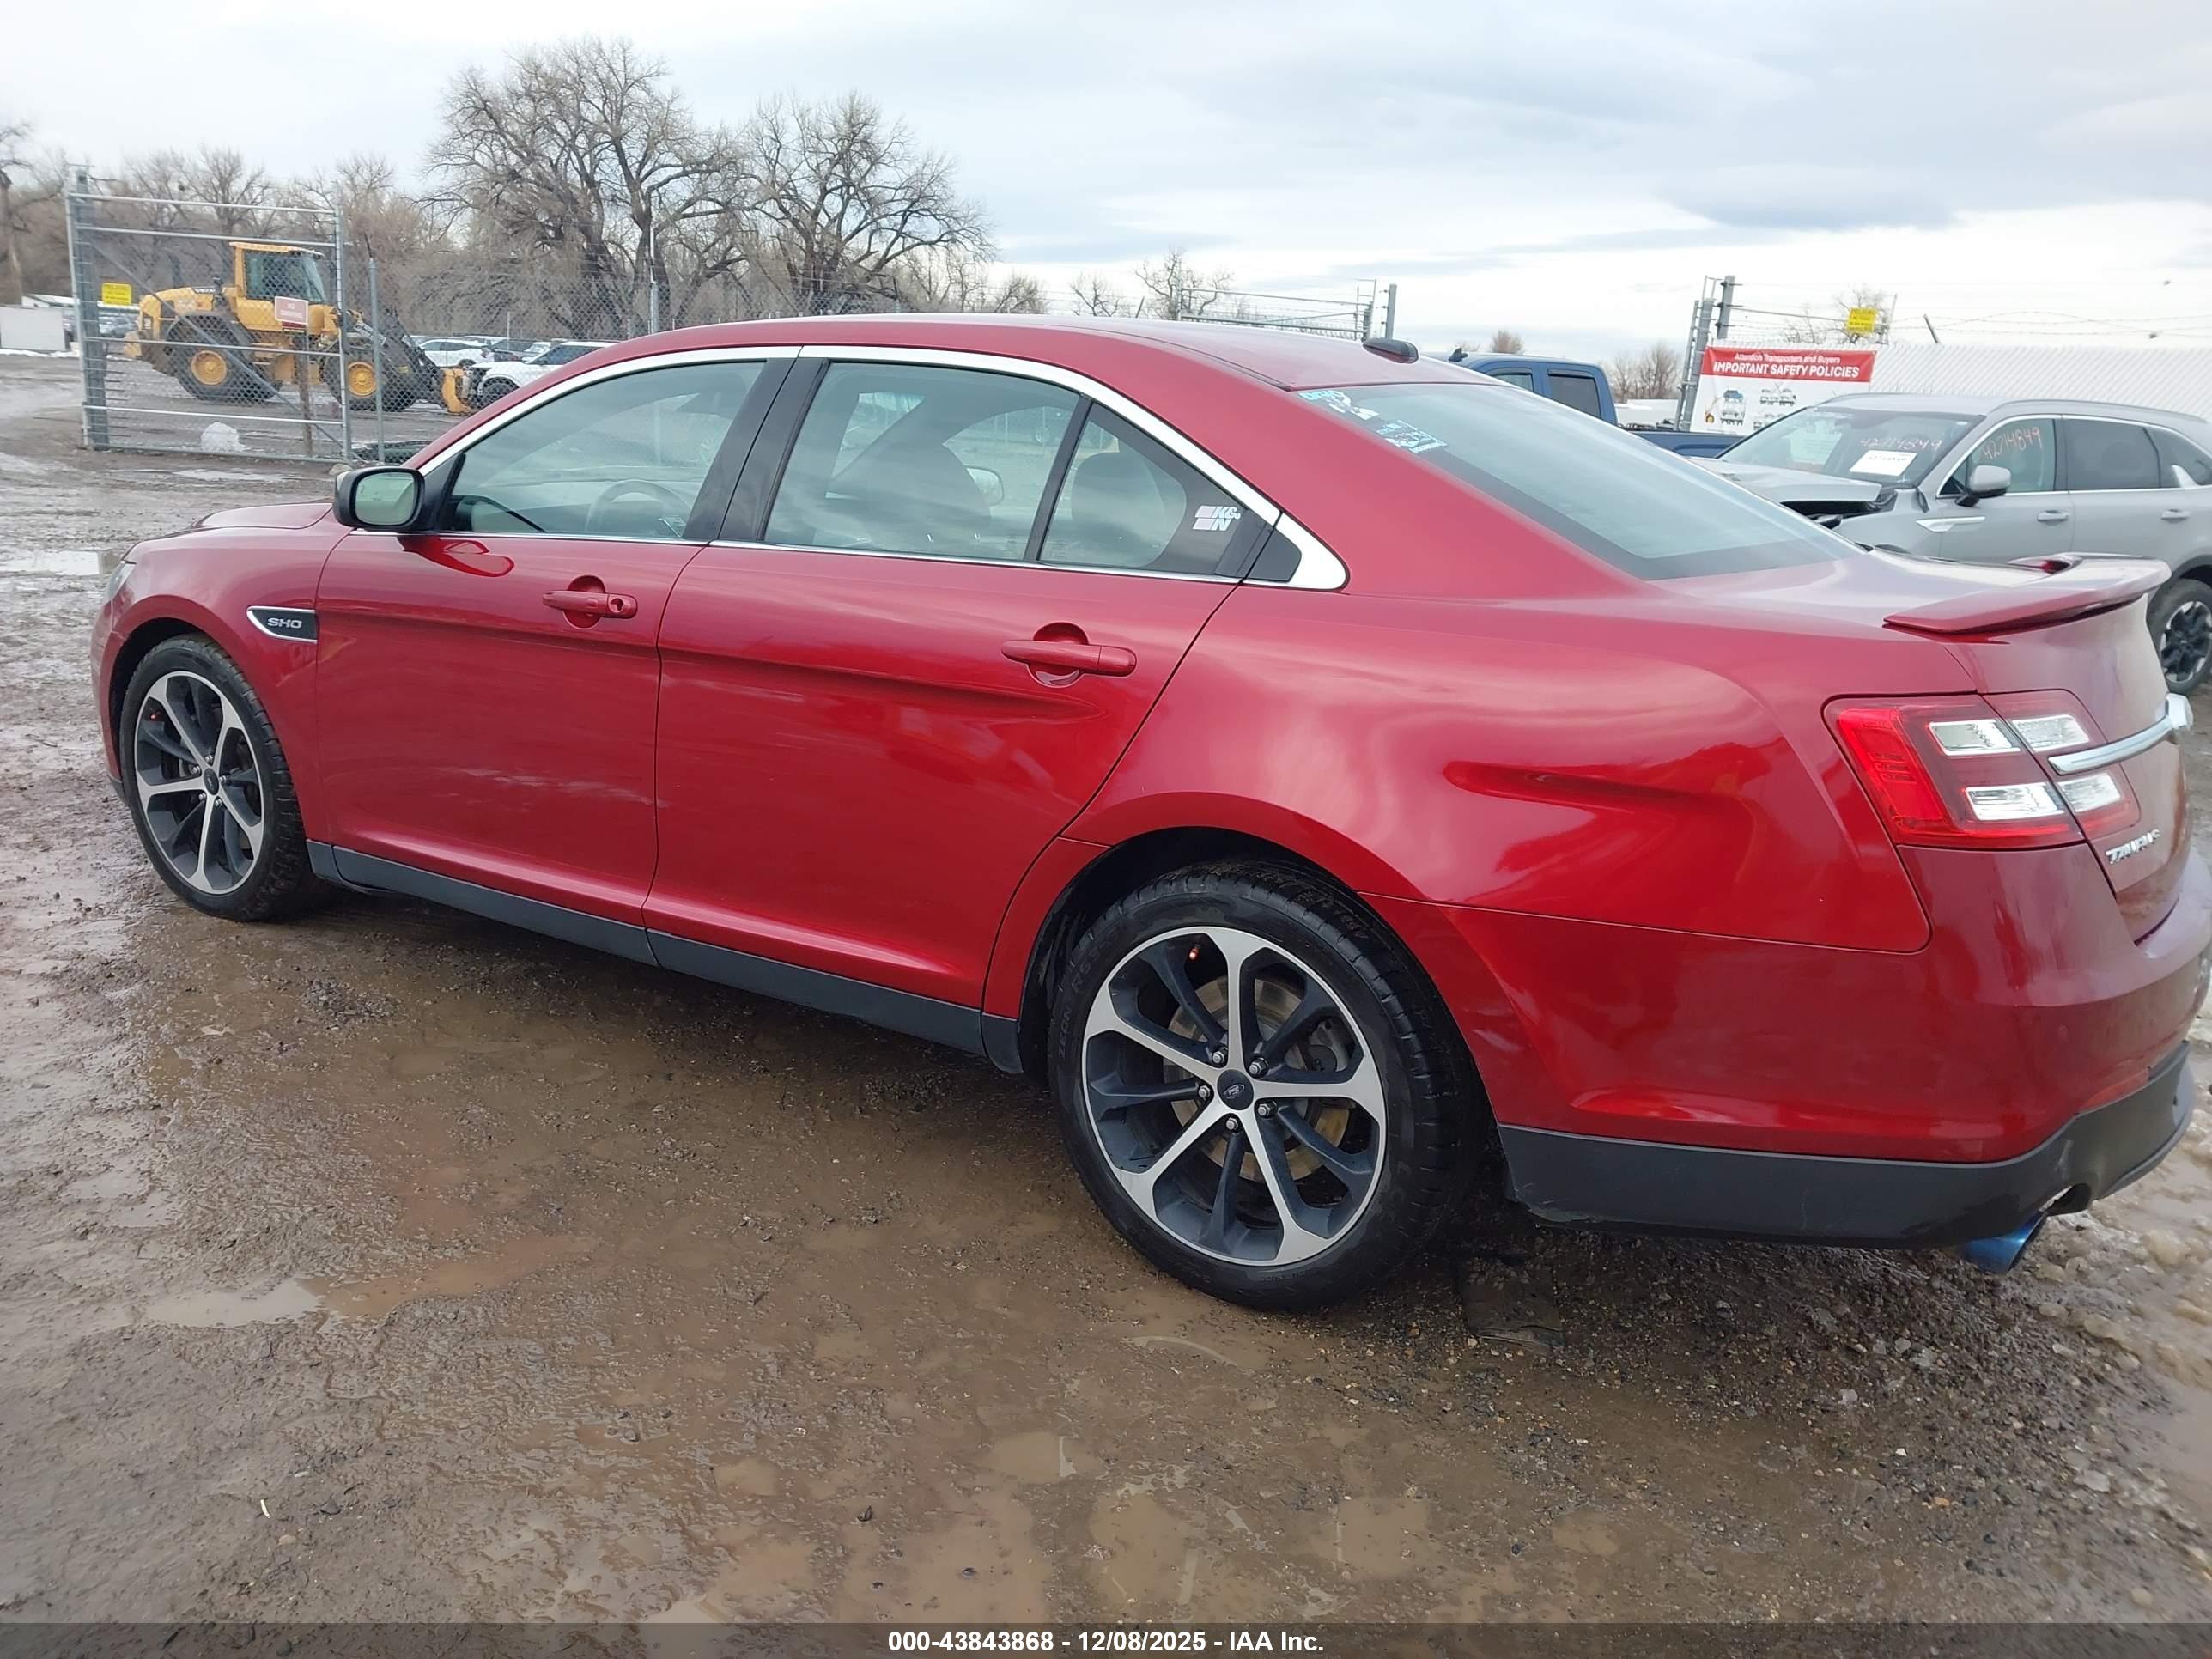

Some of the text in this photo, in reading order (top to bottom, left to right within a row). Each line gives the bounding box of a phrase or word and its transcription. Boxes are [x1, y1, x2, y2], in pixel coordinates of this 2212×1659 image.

[1735, 353, 1763, 362] Attention
[1764, 353, 1802, 364] Transporters
[1818, 355, 1841, 365] Buyers
[1713, 362, 1860, 378] IMPORTANT SAFETY POLICIES
[268, 617, 302, 629] SHO
